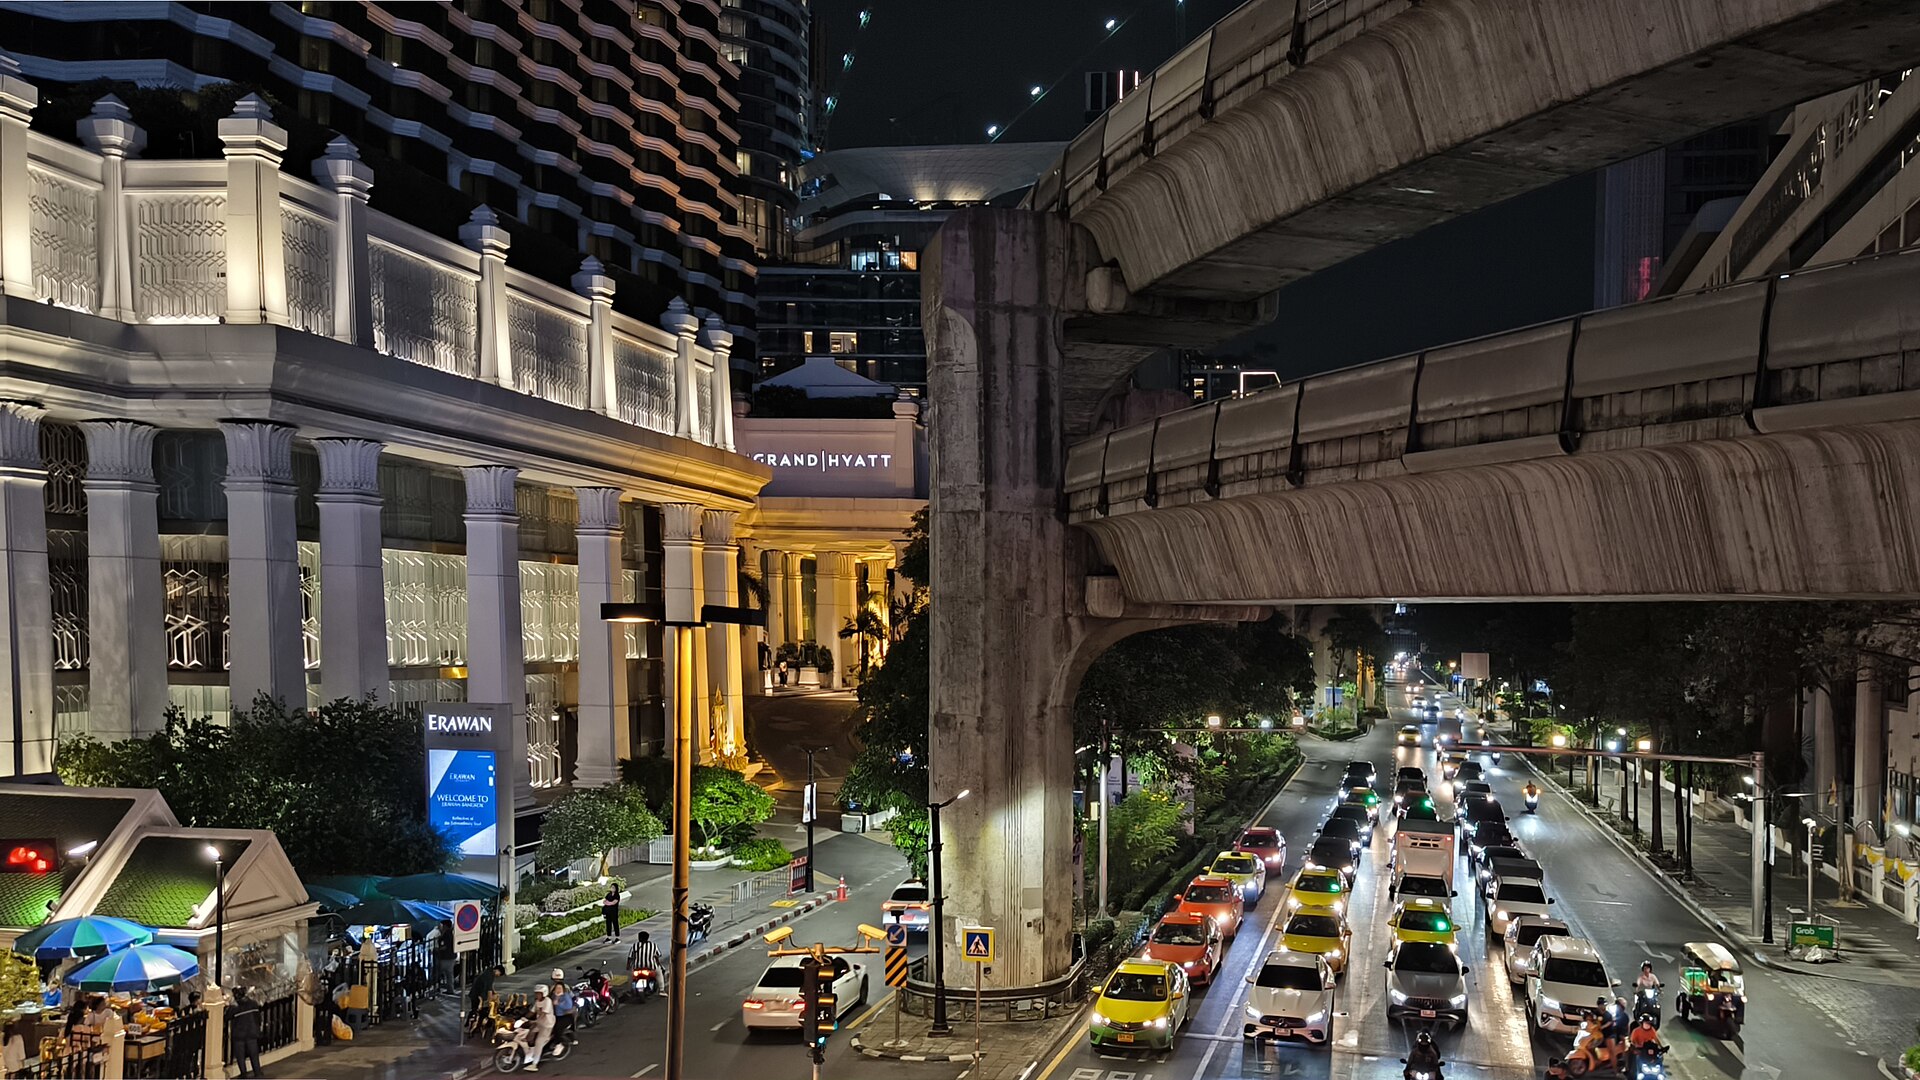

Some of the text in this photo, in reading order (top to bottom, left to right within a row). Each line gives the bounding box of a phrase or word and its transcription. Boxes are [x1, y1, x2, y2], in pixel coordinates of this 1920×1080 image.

[753, 453, 892, 467] GRAND HYATT
[429, 714, 492, 732] ERAWAN
[437, 794, 488, 803] WELCOME TO
[1796, 927, 1815, 935] Grab
